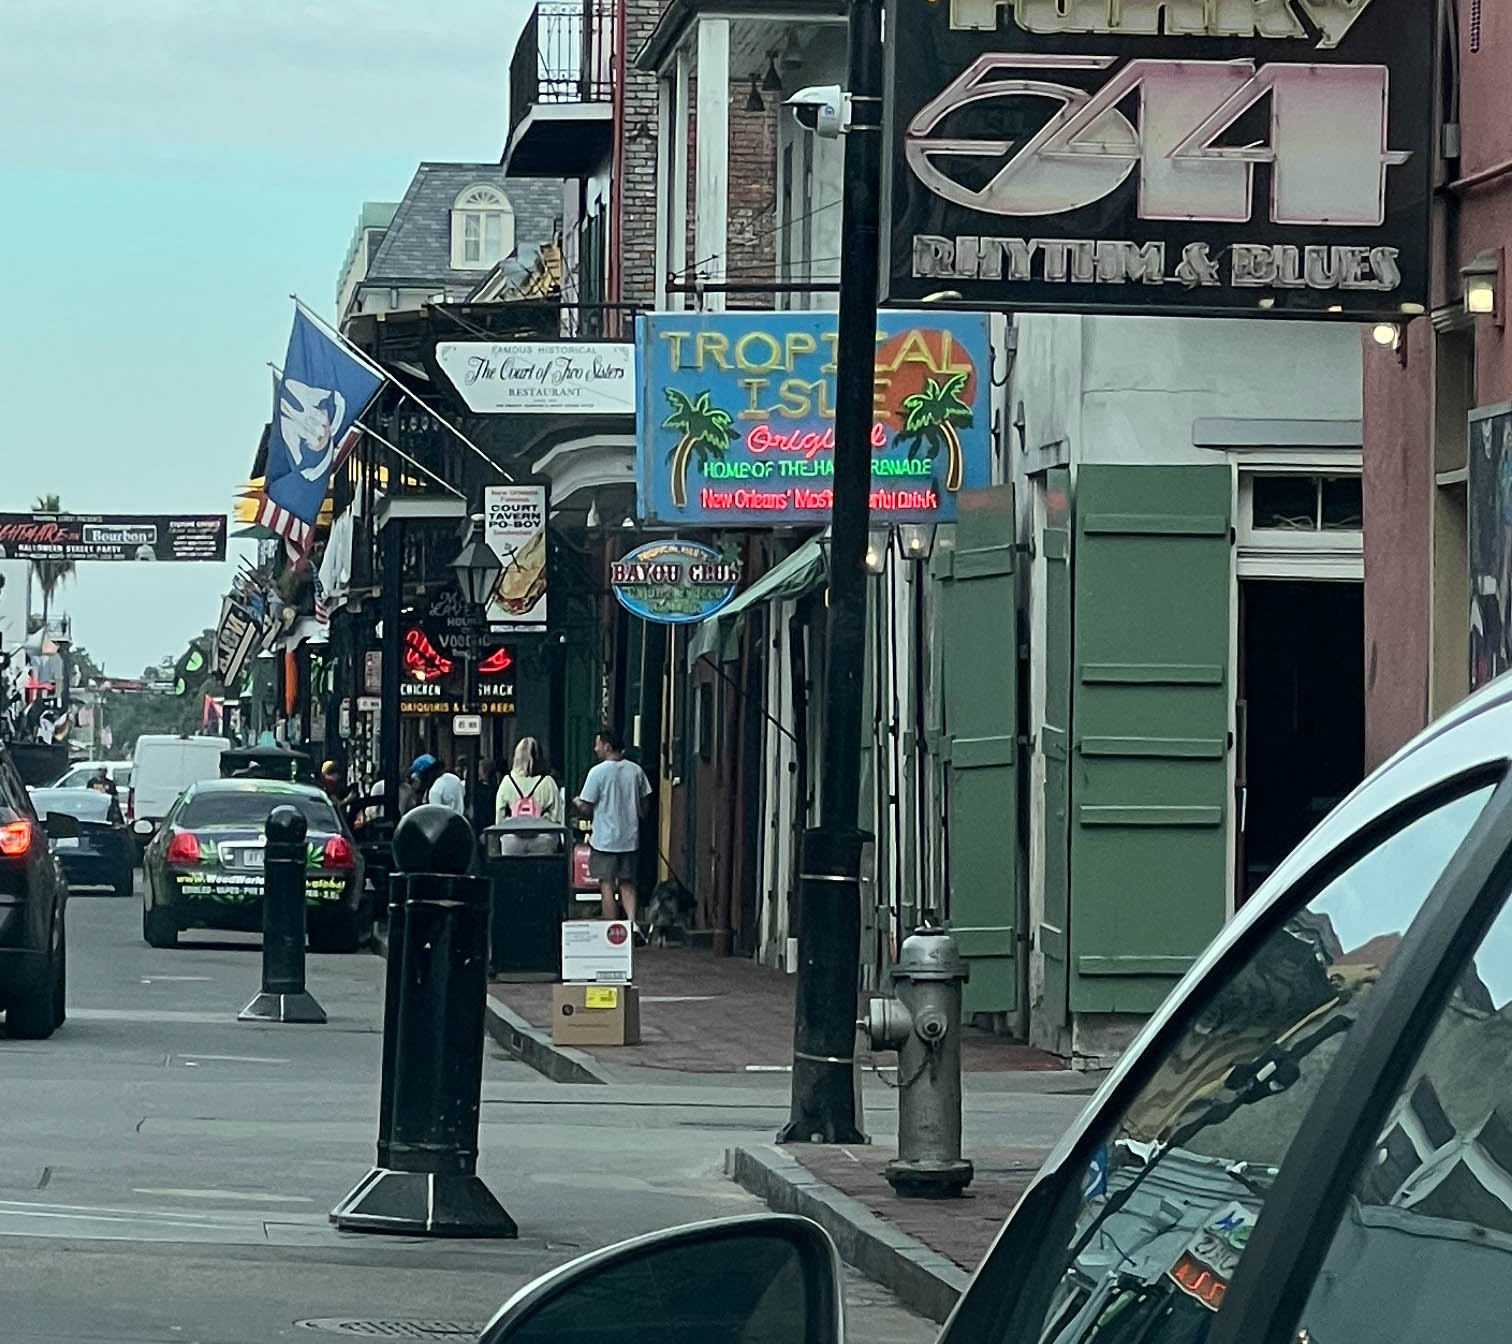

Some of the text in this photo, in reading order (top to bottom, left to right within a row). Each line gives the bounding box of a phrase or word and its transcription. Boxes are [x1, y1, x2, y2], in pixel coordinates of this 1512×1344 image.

[904, 52, 1413, 227] 544
[912, 234, 1401, 291] RHYTHM & BLUES
[492, 346, 597, 354] FAMOUS HISTORICAL
[660, 330, 973, 374] TROPIAL
[466, 356, 496, 386] The
[499, 356, 534, 380] Court
[536, 361, 552, 384] of
[586, 355, 624, 382] Sisters
[508, 388, 581, 397] RESTAURANT
[871, 459, 931, 476] RENADE
[702, 488, 732, 508] New
[491, 504, 538, 512] COURT
[489, 520, 541, 528] PO-BOY
[92, 529, 147, 542] Bourbon
[610, 561, 681, 584] BAYOU
[400, 684, 441, 696] CHICKEN
